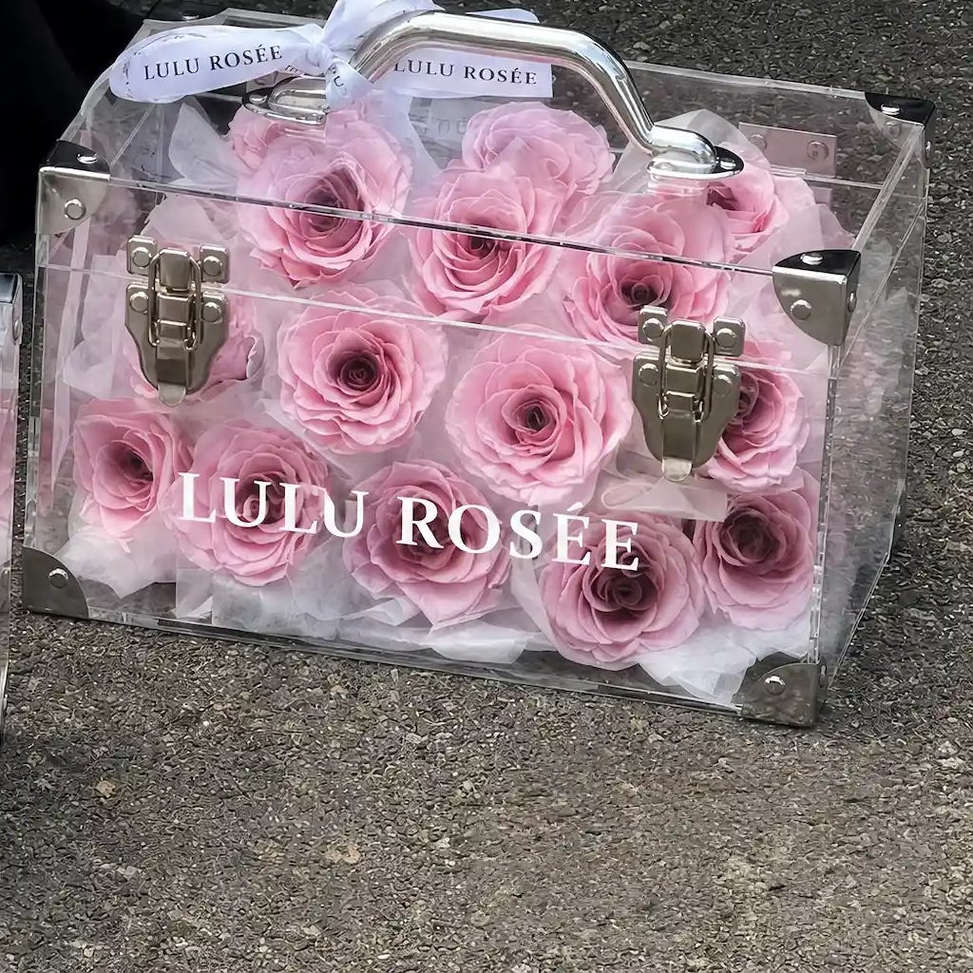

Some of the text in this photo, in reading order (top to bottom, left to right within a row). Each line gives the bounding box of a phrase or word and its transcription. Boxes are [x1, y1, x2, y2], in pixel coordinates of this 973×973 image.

[144, 57, 200, 80] LULU
[209, 44, 283, 71] ROSÉE
[393, 59, 537, 85] LULU ROSÉE
[177, 471, 640, 571] LULU ROSÉE
